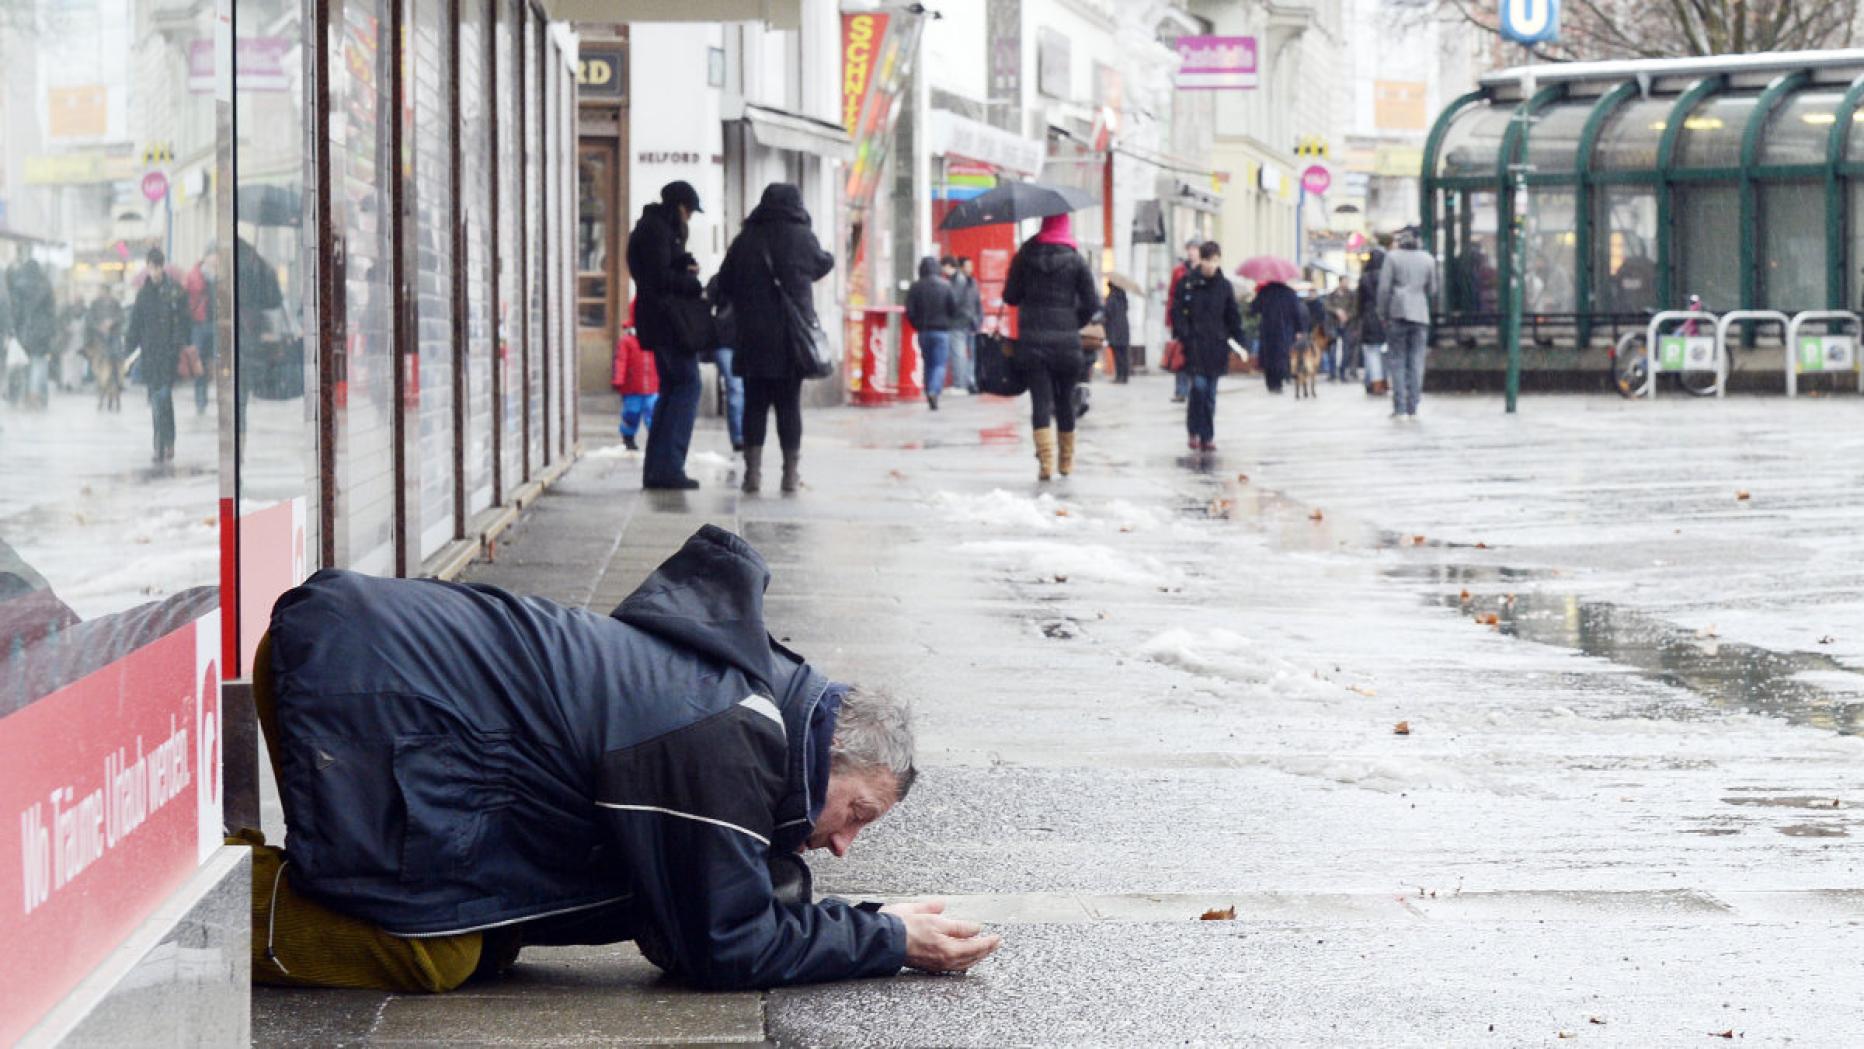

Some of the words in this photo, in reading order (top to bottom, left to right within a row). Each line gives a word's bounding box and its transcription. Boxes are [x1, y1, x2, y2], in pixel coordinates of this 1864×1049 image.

[1510, 0, 1547, 35] U
[21, 802, 49, 914] Wo
[50, 785, 104, 890] Träume
[104, 735, 146, 848] Urlaub
[146, 712, 190, 815] werden.
